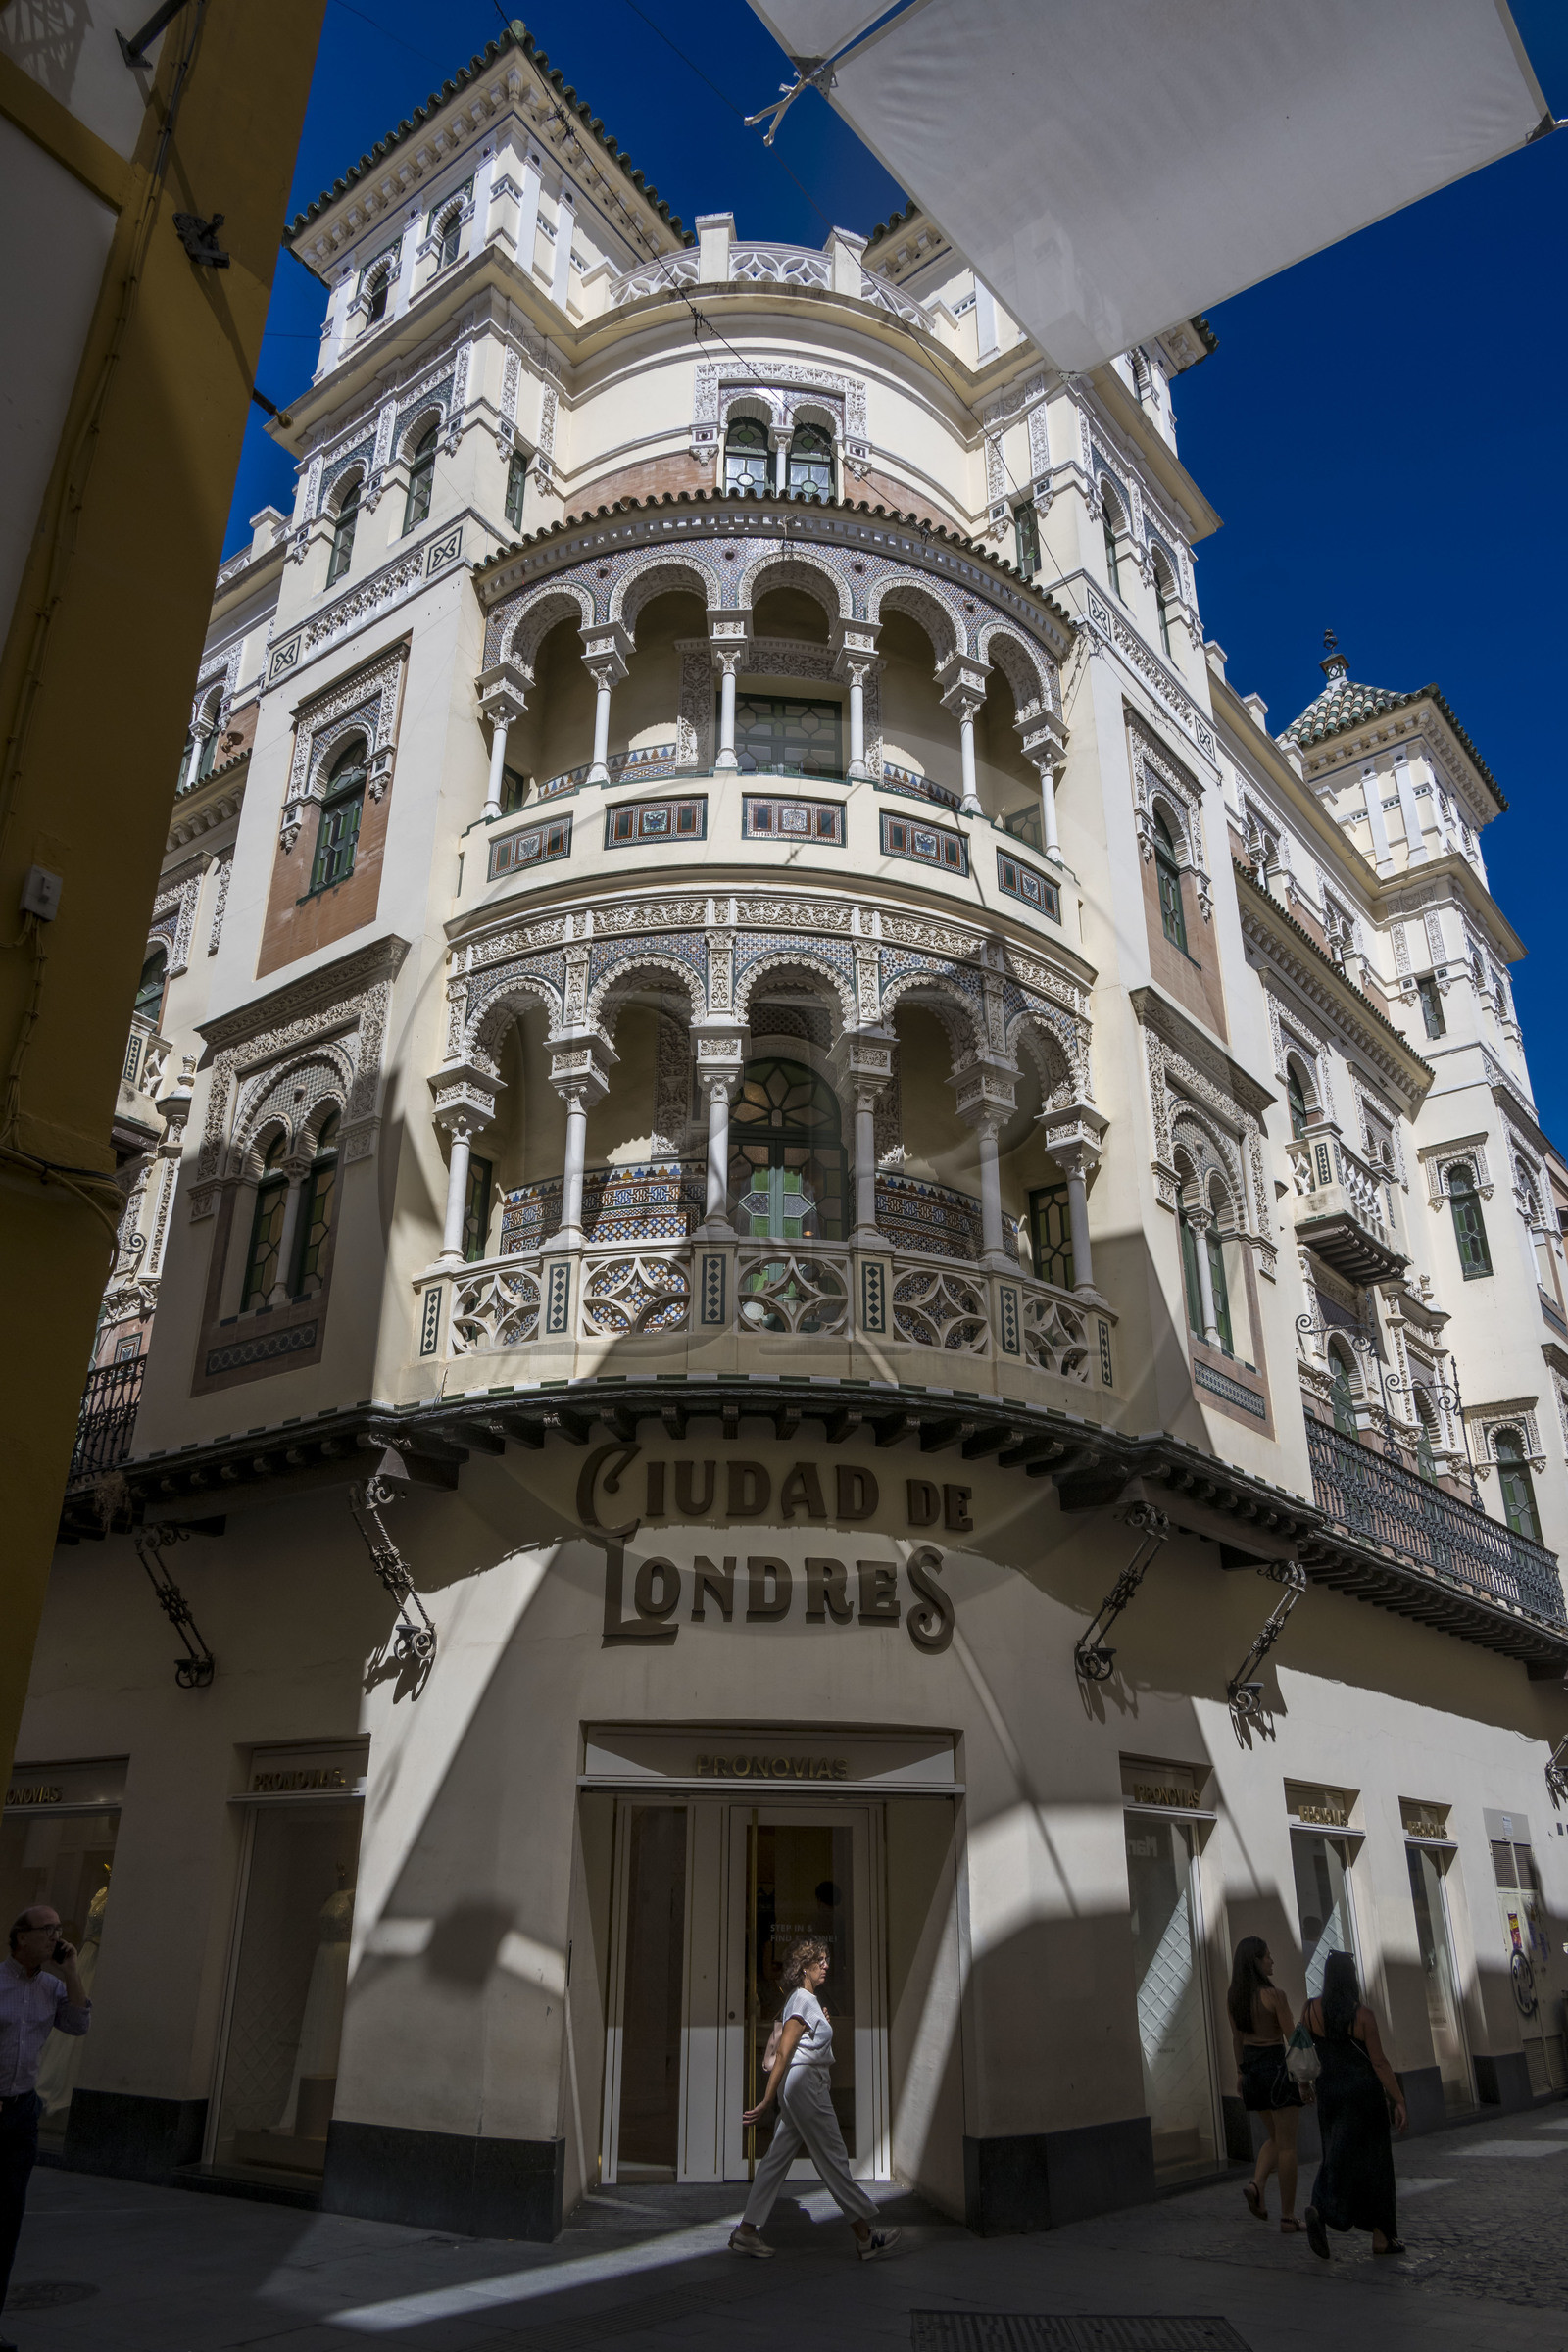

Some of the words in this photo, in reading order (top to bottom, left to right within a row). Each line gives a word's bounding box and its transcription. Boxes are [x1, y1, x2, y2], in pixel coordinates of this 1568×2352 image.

[576, 1441, 879, 1539] CIUDAD
[906, 1477, 974, 1531] DE
[602, 1538, 955, 1646] LONDRES
[696, 1754, 848, 1779] PRONOVIAS
[253, 1767, 346, 1791] PRONOVIAS
[6, 1786, 63, 1804] ONOVIAS
[1134, 1783, 1200, 1809] PRONOVIAS
[769, 1923, 792, 1933] STEP
[795, 1924, 804, 1933] IN
[770, 1934, 793, 1942] FIND
